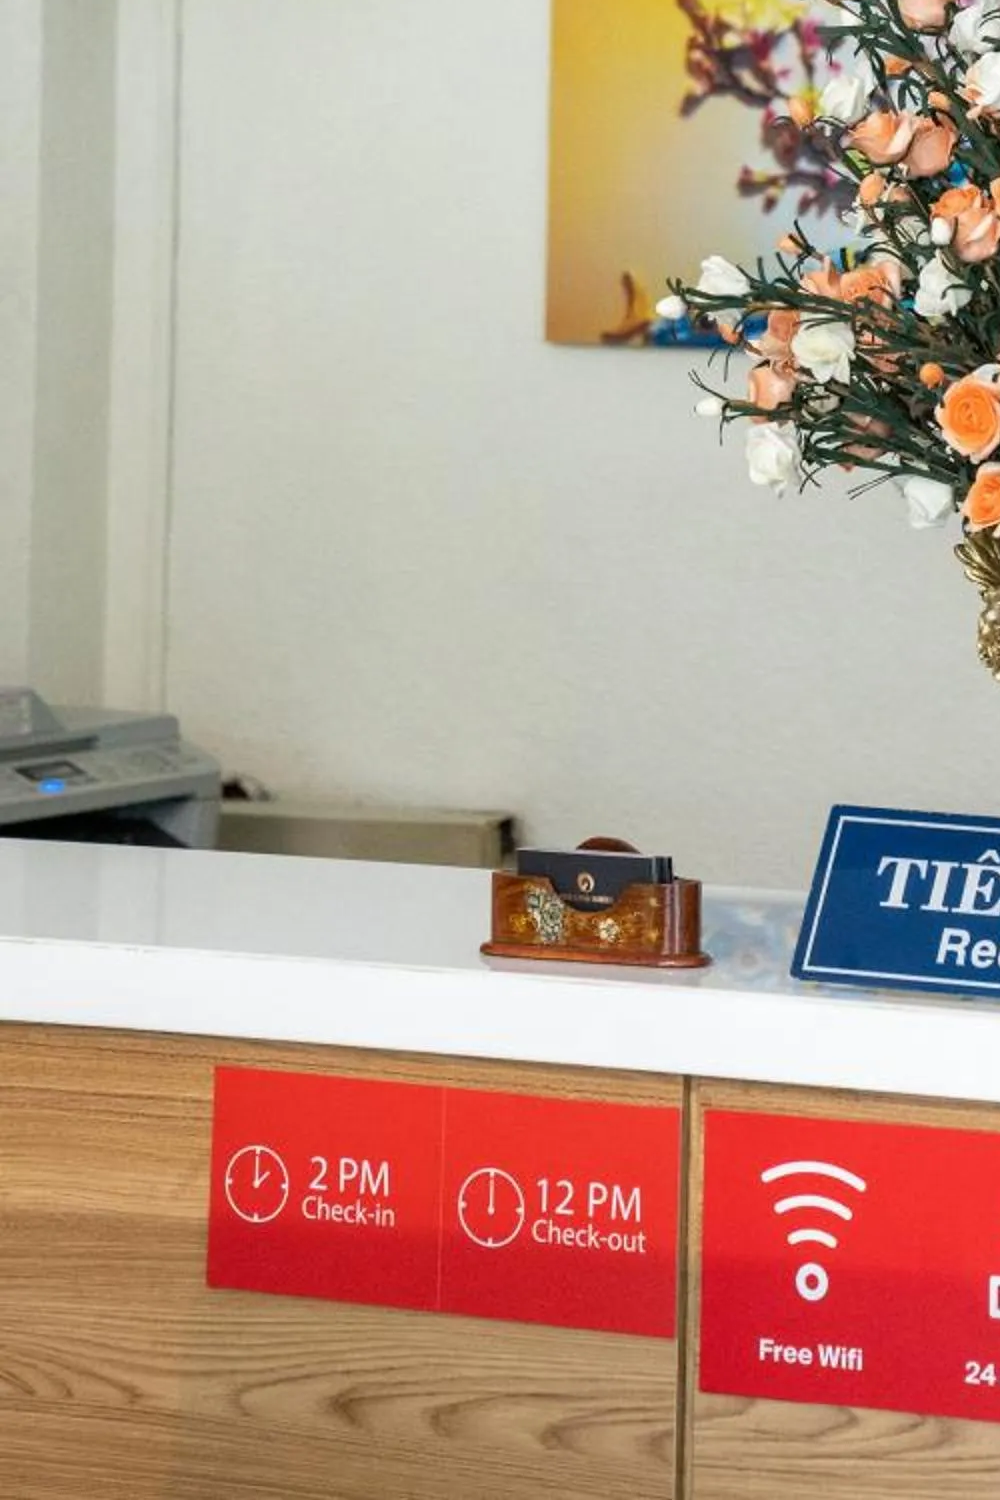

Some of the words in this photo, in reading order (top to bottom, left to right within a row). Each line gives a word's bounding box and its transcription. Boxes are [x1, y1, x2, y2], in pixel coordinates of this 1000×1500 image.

[309, 1156, 328, 1191] 2
[339, 1157, 390, 1197] PM
[302, 1195, 395, 1227] Check-in
[537, 1178, 574, 1216] 12
[588, 1182, 641, 1222] PM
[531, 1218, 646, 1254] Check-out
[759, 1338, 812, 1366] Free
[818, 1343, 863, 1371] Wifi
[964, 1361, 997, 1386] 24
